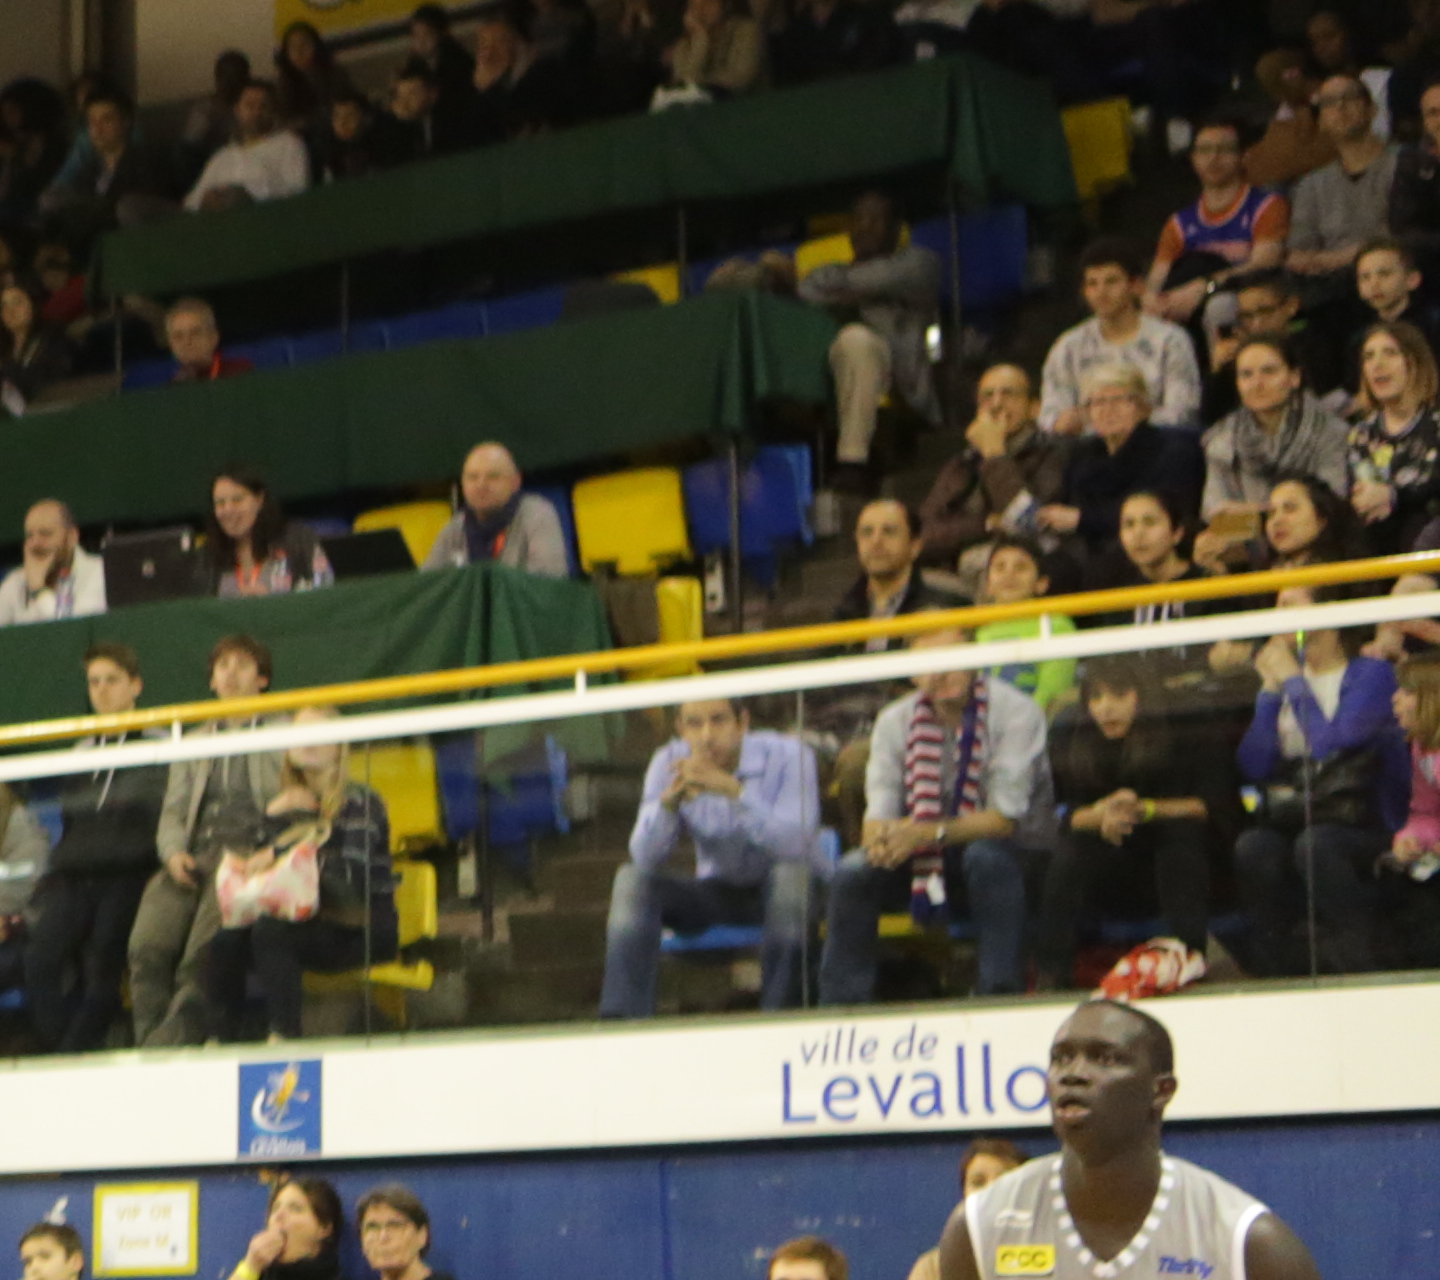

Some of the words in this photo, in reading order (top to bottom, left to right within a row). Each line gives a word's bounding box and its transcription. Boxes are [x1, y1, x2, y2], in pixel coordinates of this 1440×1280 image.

[801, 1026, 879, 1067] ville
[893, 1021, 938, 1061] de
[782, 1043, 1051, 1124] Levallo
